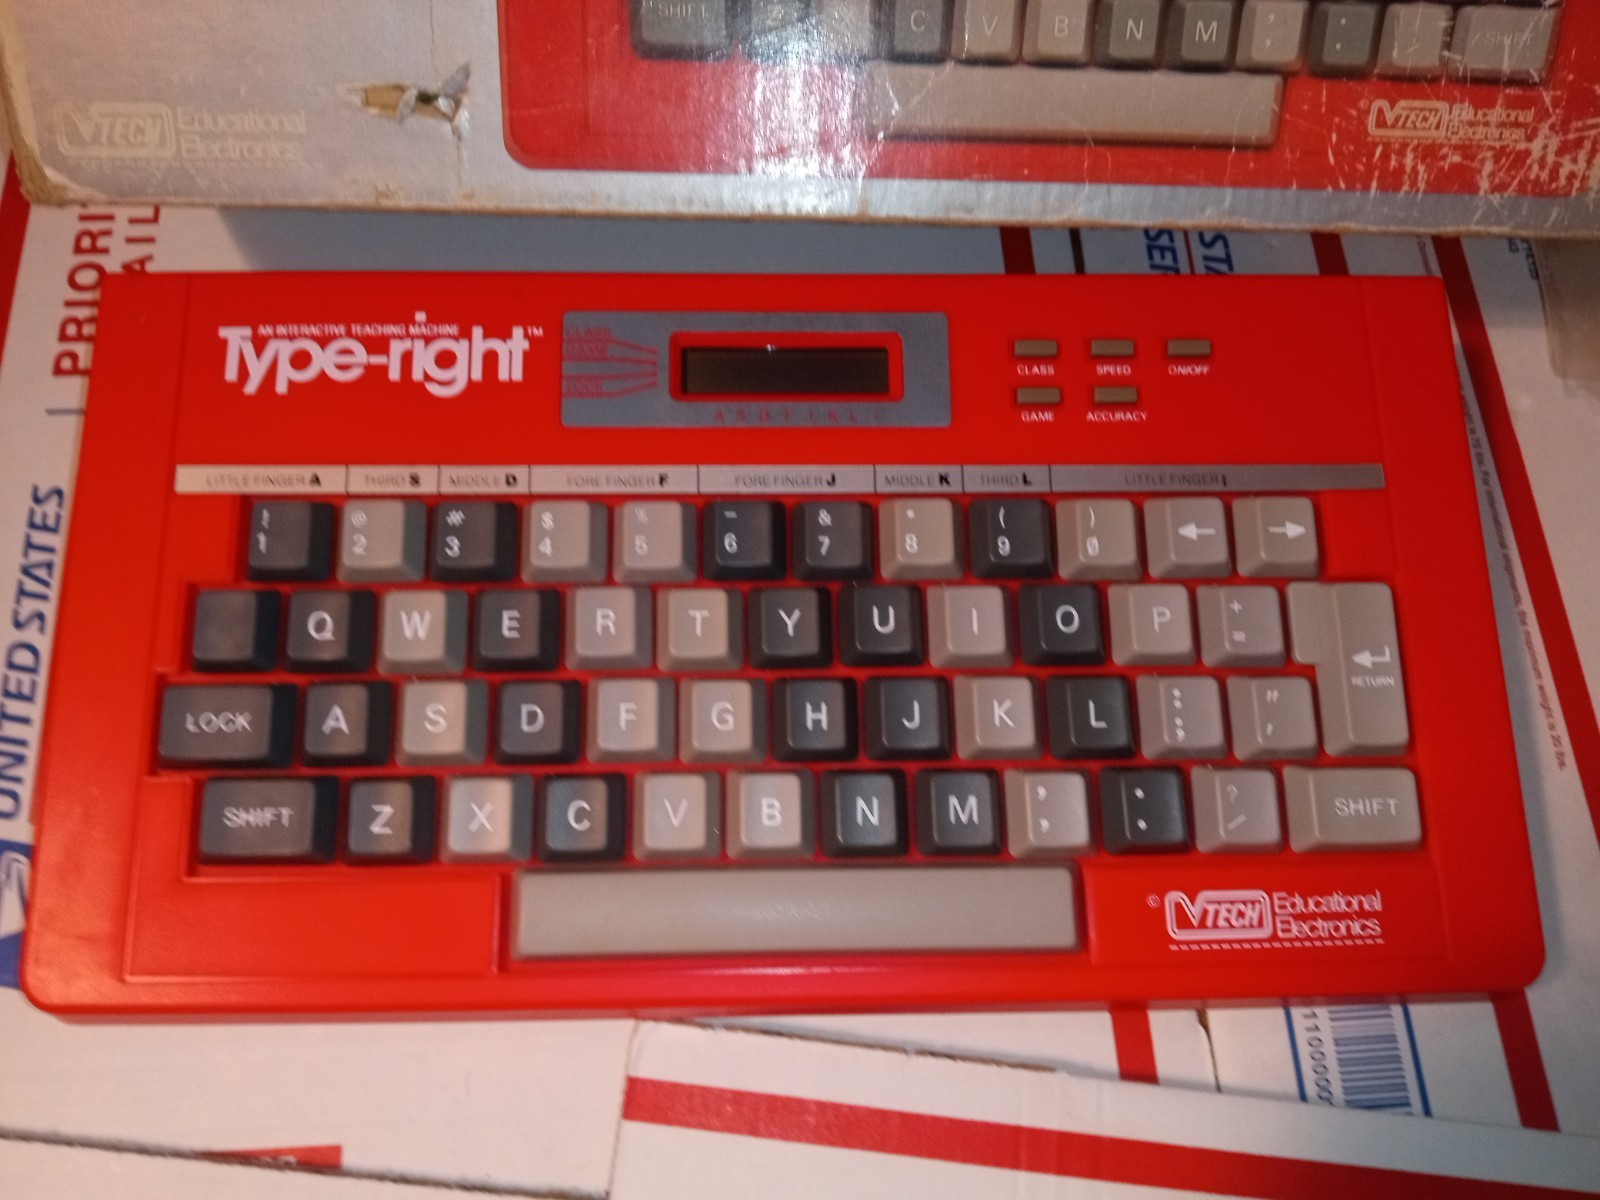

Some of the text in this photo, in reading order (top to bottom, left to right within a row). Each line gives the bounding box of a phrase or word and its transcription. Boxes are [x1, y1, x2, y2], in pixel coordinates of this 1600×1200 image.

[910, 11, 926, 33] C
[982, 15, 998, 34] V
[1055, 17, 1069, 36] B
[1126, 18, 1144, 41] N
[1195, 20, 1218, 42] M
[1143, 229, 1180, 274] SE
[53, 204, 115, 377] PRIORI
[257, 323, 273, 337] AN
[275, 323, 347, 337] INTERACTIVE
[351, 323, 406, 337] TEACHING
[218, 310, 530, 398] Type-right
[1017, 364, 1055, 376] CLASS
[1096, 364, 1131, 376] SPEED
[1021, 411, 1054, 422] GAME
[1086, 410, 1148, 422] ACCURACY
[253, 474, 306, 488] FINGER
[308, 472, 322, 487] A
[505, 473, 517, 487] D
[567, 474, 602, 488] FORE
[605, 474, 656, 488] FINGER
[734, 472, 836, 488] FORE FINGER J
[884, 473, 951, 487] MIDDLE K
[979, 472, 1032, 487] THIRD L
[1124, 473, 1168, 487] LITTLE
[1172, 473, 1219, 487] FINGER
[351, 533, 368, 555] 2
[444, 535, 461, 558] 3
[538, 535, 554, 557] 4
[634, 534, 648, 555] 5
[723, 532, 738, 554] 6
[817, 534, 831, 556] 7
[904, 533, 919, 554] 8
[997, 535, 1011, 557] 9
[307, 610, 336, 642] Q
[400, 609, 432, 641] W
[501, 609, 521, 639] E
[595, 607, 617, 637] R
[687, 608, 710, 638] T
[777, 607, 801, 638] Y
[872, 604, 896, 635] U
[1054, 604, 1081, 634] O
[1151, 605, 1172, 633] P
[0, 483, 65, 821] UNITED STATES
[1351, 675, 1395, 688] RETURN
[185, 711, 253, 734] LOCK
[320, 703, 350, 735] A
[423, 702, 448, 734] S
[519, 702, 545, 734] D
[618, 701, 639, 731] F
[710, 700, 736, 732] G
[804, 701, 829, 732] H
[901, 699, 921, 730] J
[992, 698, 1016, 728] K
[1087, 698, 1108, 729] L
[221, 806, 295, 829] SHIFT
[368, 803, 395, 836] Z
[467, 800, 494, 833] X
[566, 799, 592, 832] C
[663, 797, 689, 829] V
[759, 796, 783, 827] B
[855, 795, 880, 828] N
[947, 793, 980, 826] M
[1333, 797, 1399, 818] SHIFT
[1164, 889, 1270, 938] VTECH
[1272, 889, 1383, 915] Educational
[1275, 914, 1382, 938] Electronics
